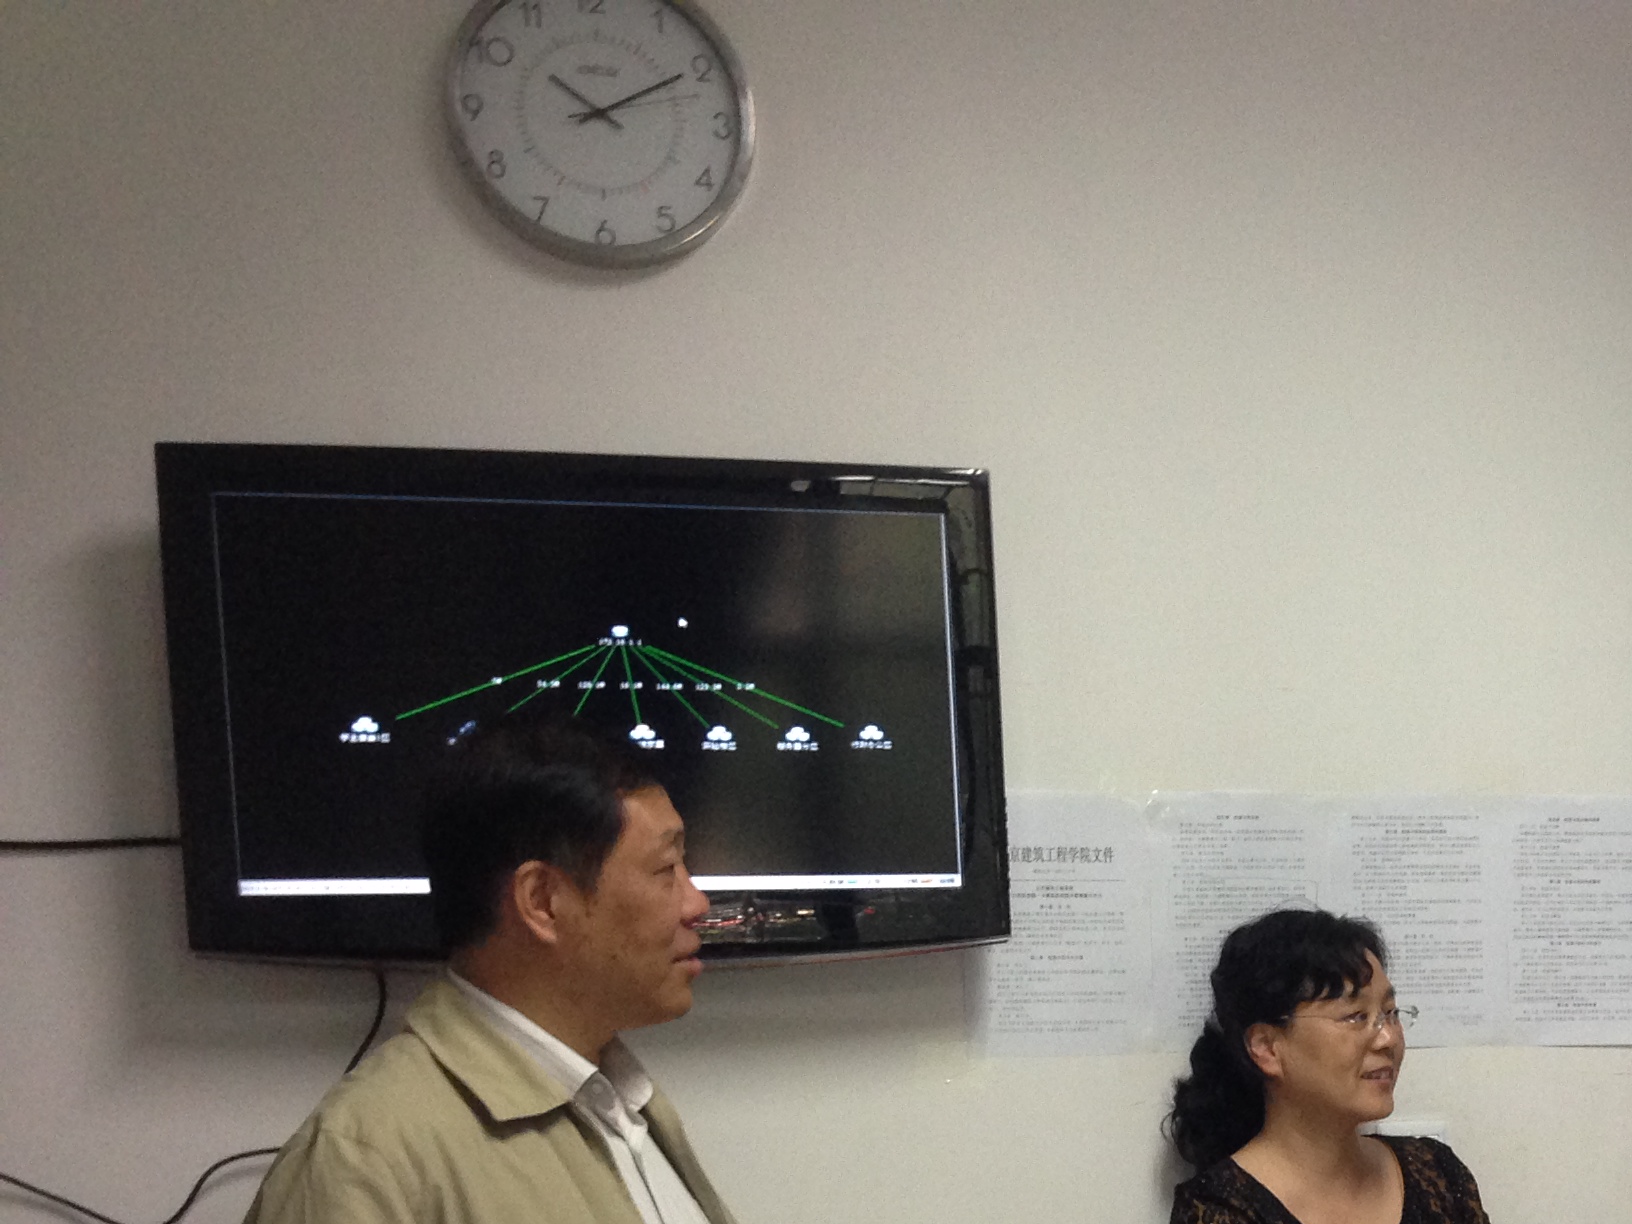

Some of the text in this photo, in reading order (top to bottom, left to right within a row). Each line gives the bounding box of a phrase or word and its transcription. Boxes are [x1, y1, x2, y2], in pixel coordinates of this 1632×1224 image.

[518, 1, 542, 29] 11
[652, 8, 665, 34] 1
[690, 54, 713, 83] 2
[461, 93, 484, 122] 9
[712, 111, 732, 140] 3
[485, 149, 507, 179] 8
[694, 165, 714, 192] 4
[532, 195, 551, 224] 7
[655, 205, 676, 233] 5
[594, 218, 616, 247] 6
